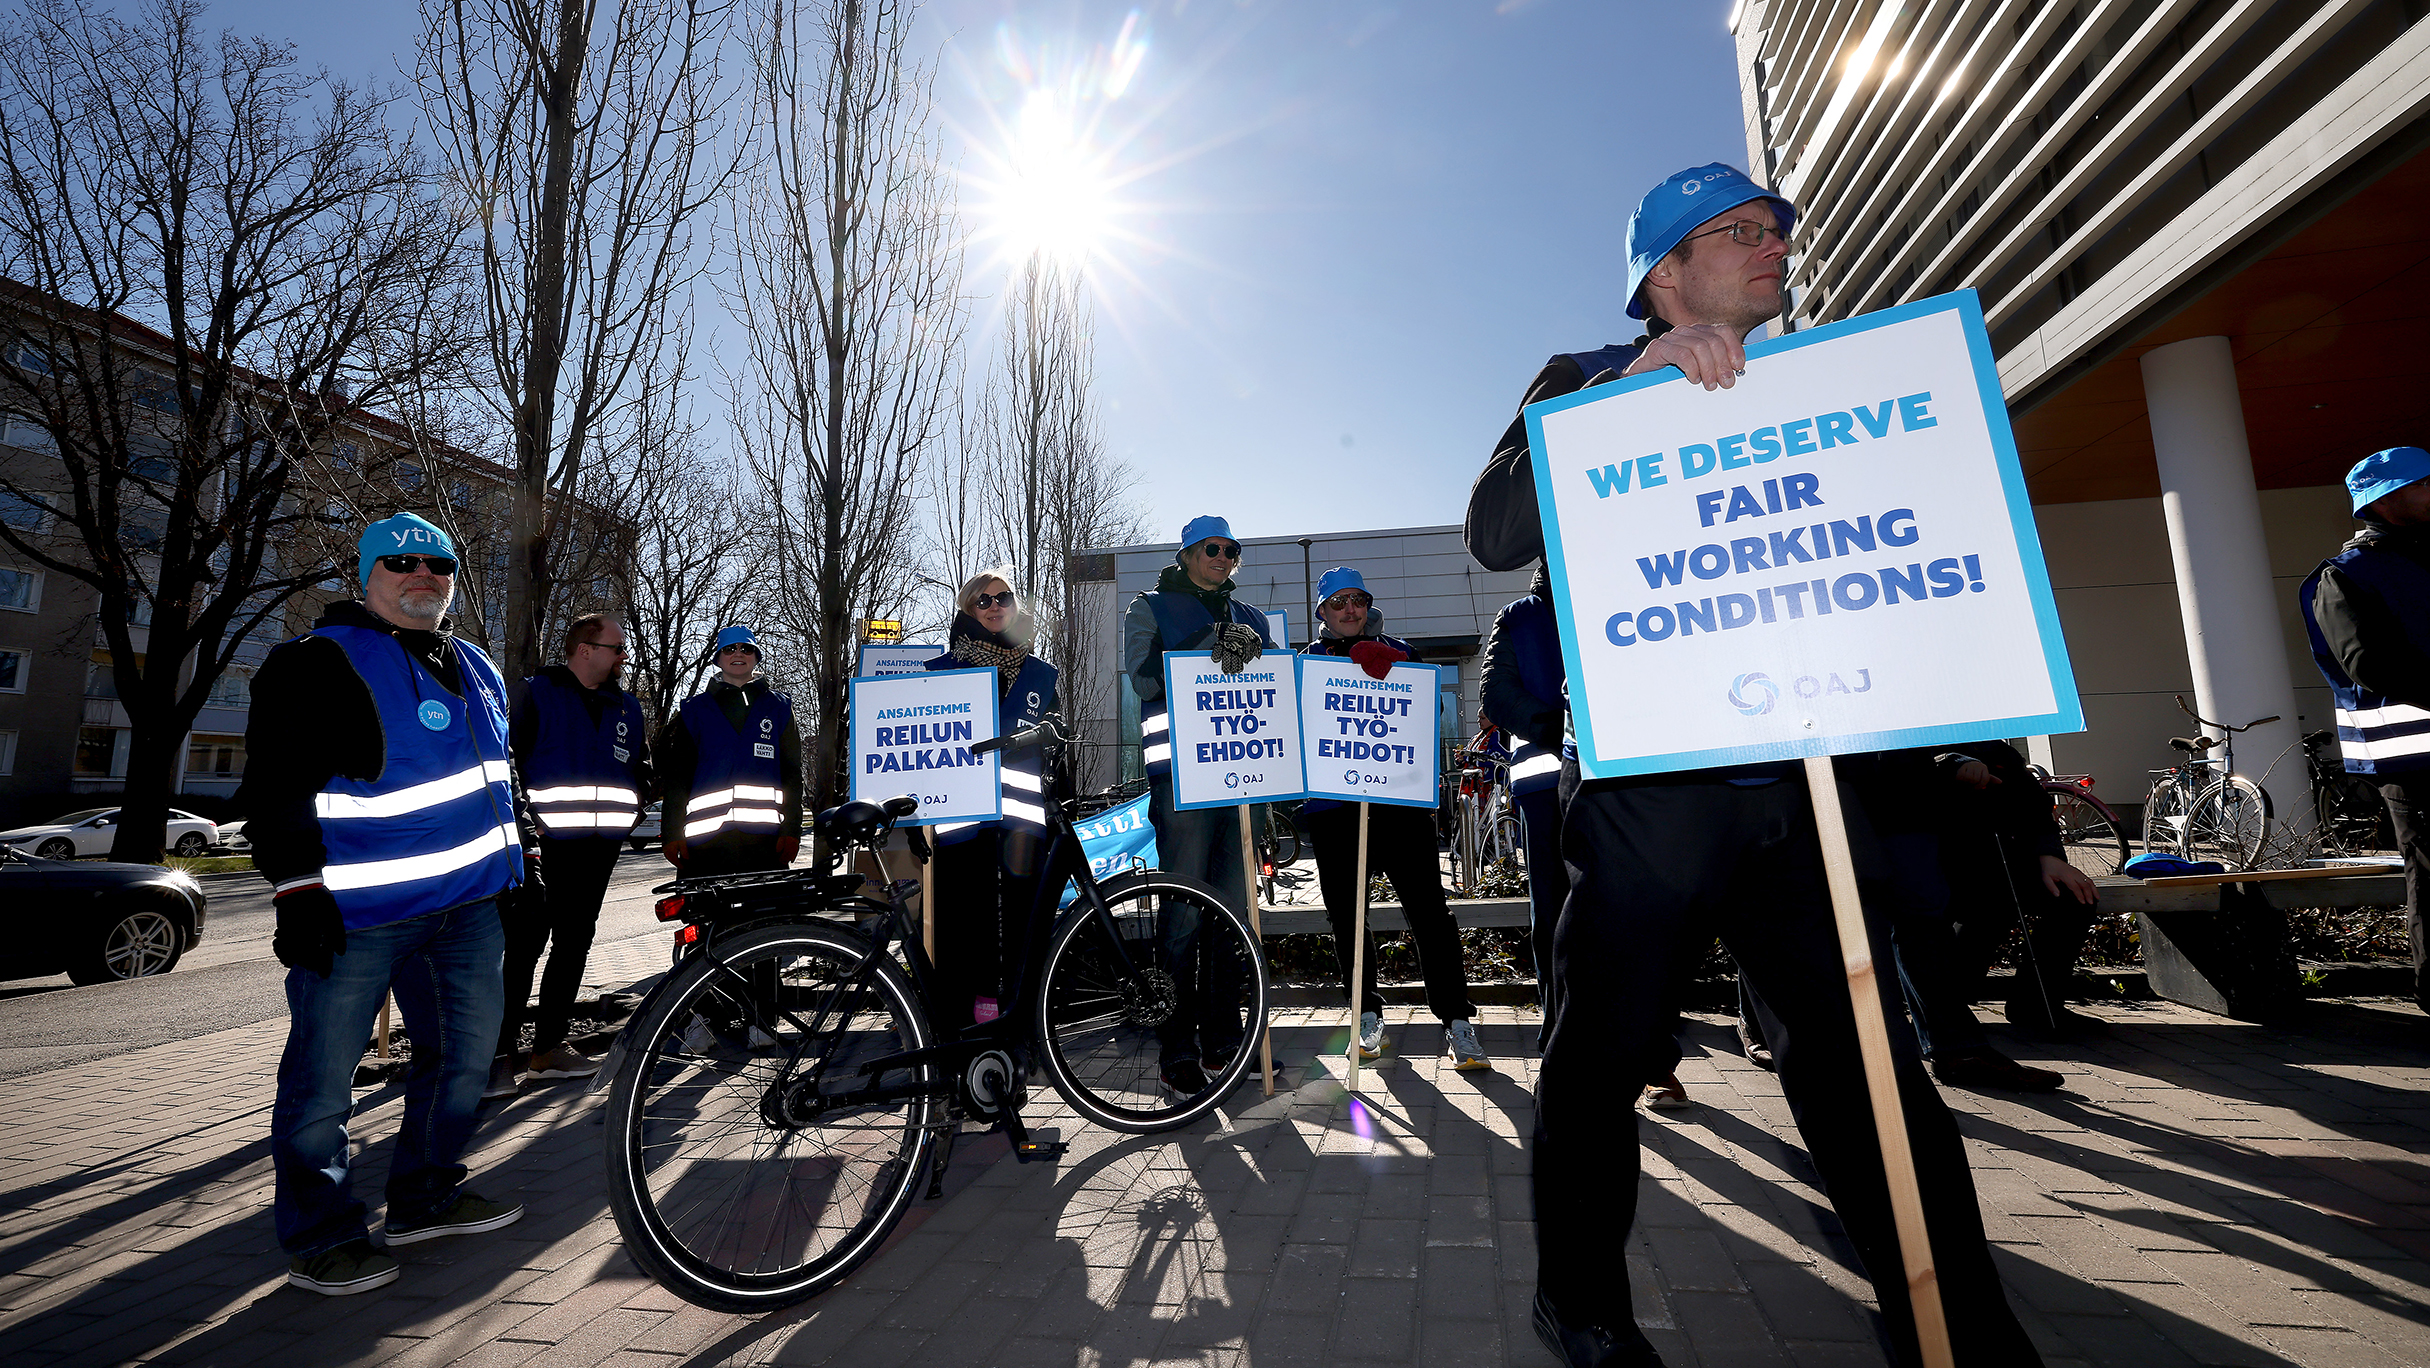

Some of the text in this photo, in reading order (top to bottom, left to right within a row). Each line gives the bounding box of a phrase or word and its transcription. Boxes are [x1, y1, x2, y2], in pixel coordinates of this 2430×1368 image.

[1703, 171, 1732, 182] OAJ
[1585, 390, 1939, 500] WE DESERVE
[1695, 472, 1826, 529] FAIR
[390, 527, 442, 548] ytn
[1635, 507, 1920, 590] WORKING
[1604, 553, 1988, 648] CONDITIONS!
[875, 659, 925, 667] ANSAITSEMM
[1194, 672, 1276, 685] ANSAITSEMME
[1325, 677, 1413, 693] ANSAITSEMME
[1792, 667, 1873, 700] OAJ
[876, 702, 972, 720] ANSAITSEMME
[1195, 688, 1277, 712] REILUT
[1324, 692, 1413, 717] REILUT
[427, 710, 444, 720] ytn
[1209, 708, 1267, 736] TYÖ-
[1336, 714, 1398, 739] TYÖ-
[876, 720, 973, 748] REILUN
[865, 746, 984, 774] PALKAN!
[1195, 737, 1285, 764] EHDOT!
[1318, 738, 1415, 765] EHDOT!
[1242, 773, 1265, 784] OAJ
[1363, 774, 1388, 785] OAJ
[923, 794, 948, 805] OAJ
